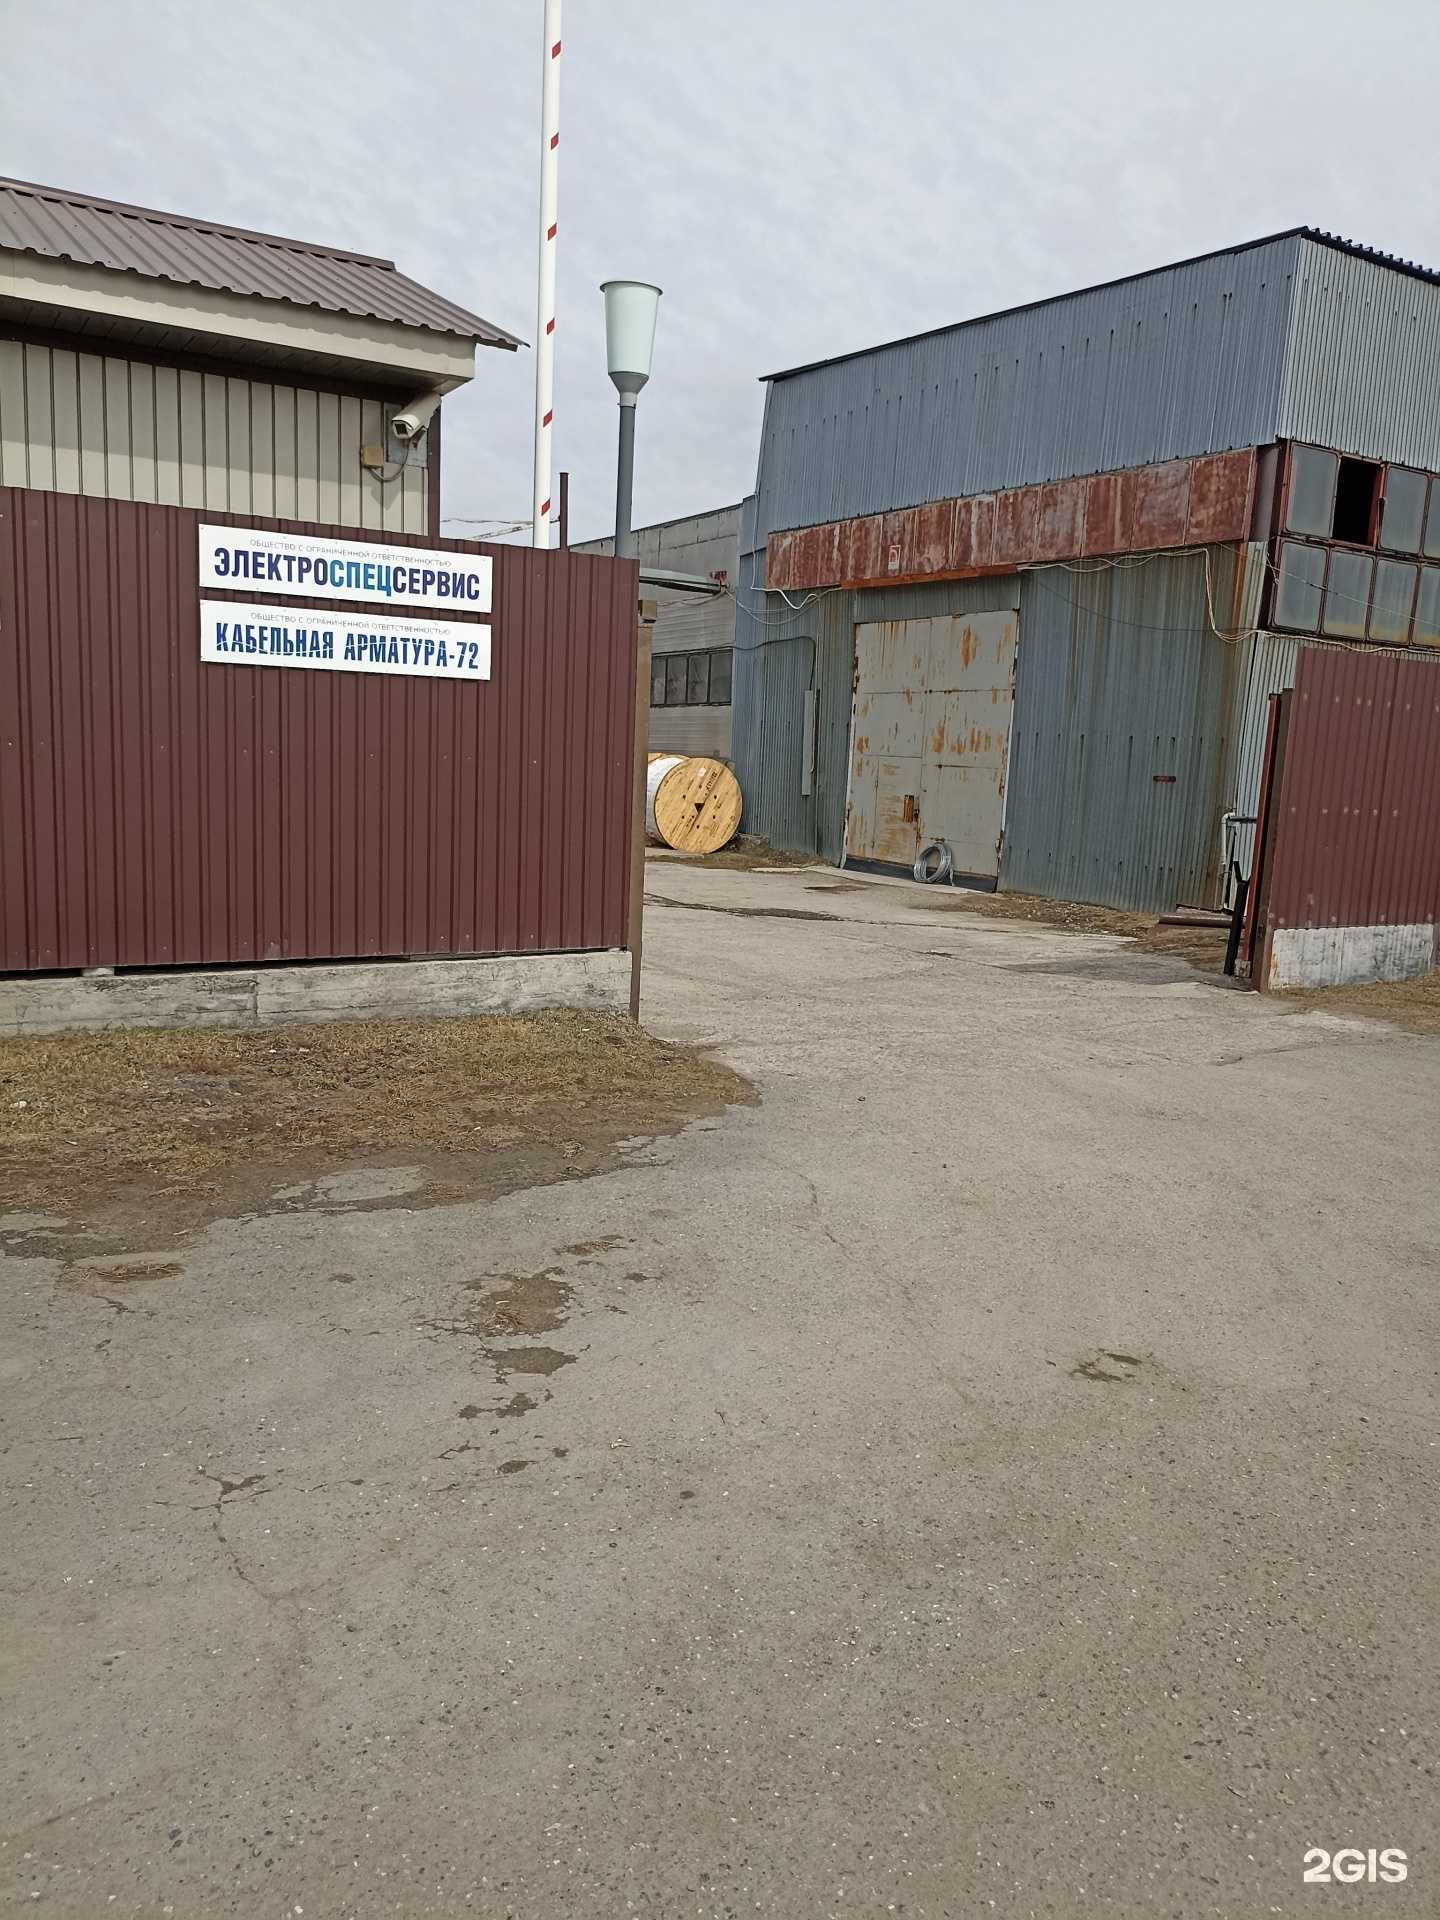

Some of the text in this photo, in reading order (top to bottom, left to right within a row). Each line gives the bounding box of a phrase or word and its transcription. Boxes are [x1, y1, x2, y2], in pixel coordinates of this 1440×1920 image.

[249, 538, 452, 567] ОБЩЕСТВО С ОГРАНИЧЕННОЙ ОТВЕТСТВЕННОСТЬЮ
[214, 547, 480, 600] ЭЛЕКТРОСПЕЦСЕРВИС
[250, 612, 451, 635] ОБЩЕСТВО С ОГРАНИЧЕННОЙ ОТВЕТСТВЕННОСТЬЮ
[216, 622, 479, 670] КАБЕЛЬНАЯ АРМАТУРА-72
